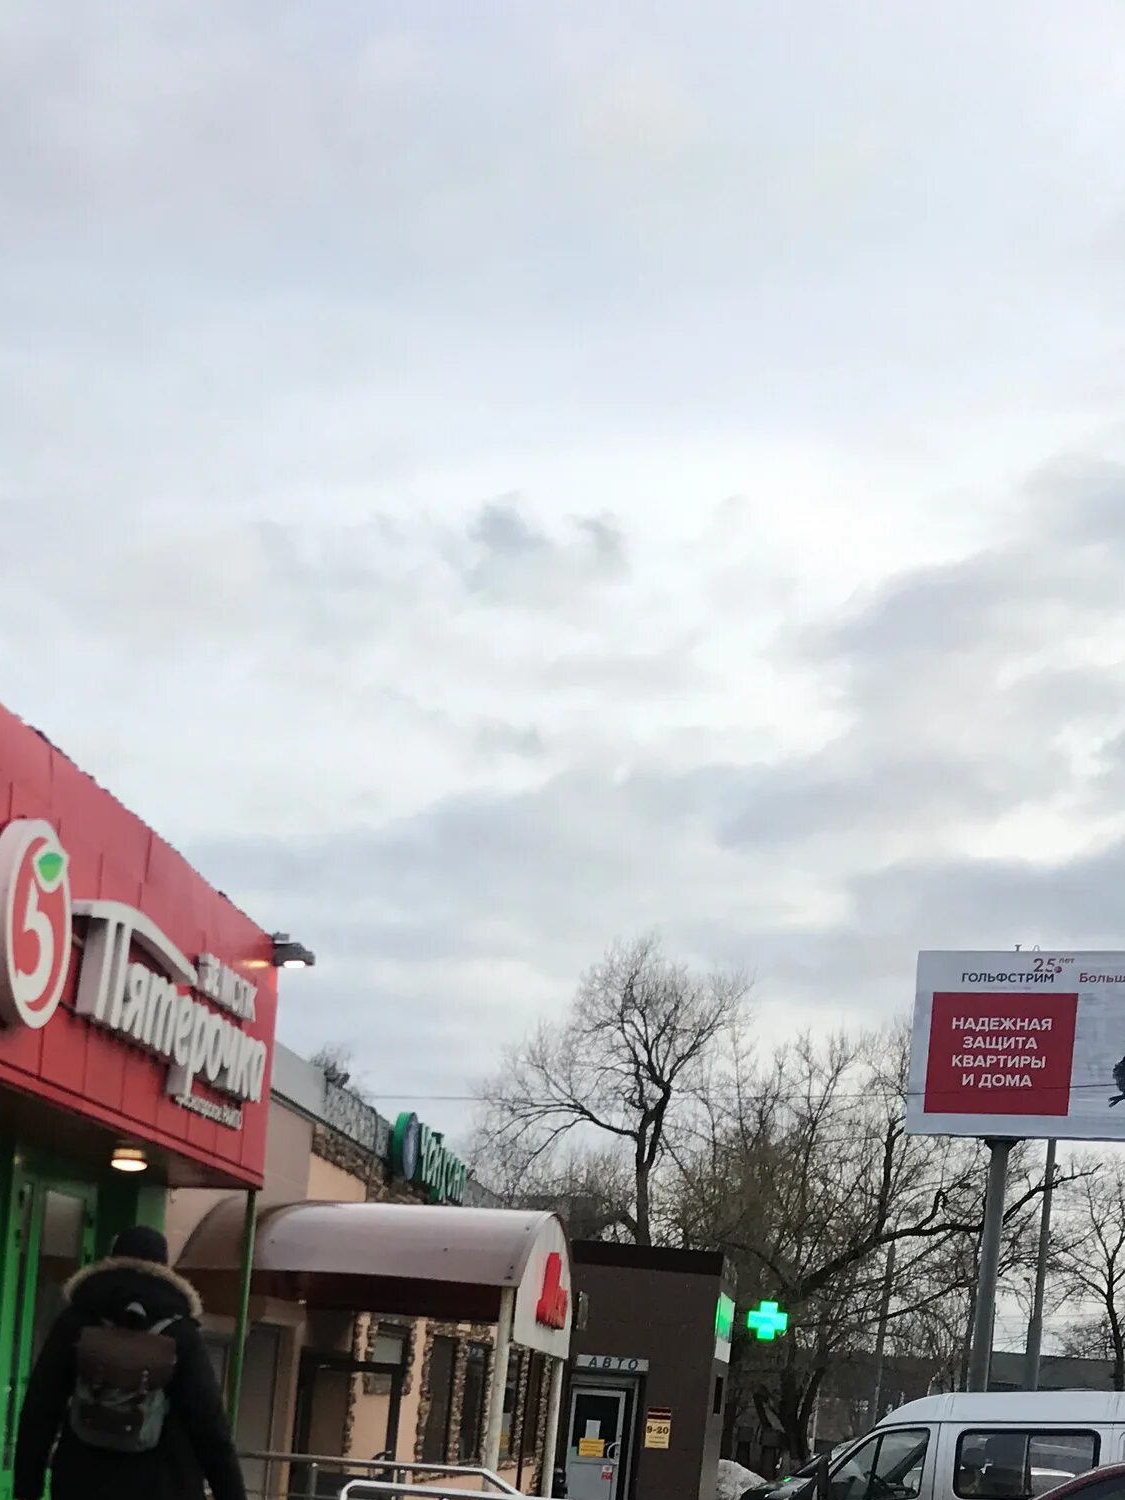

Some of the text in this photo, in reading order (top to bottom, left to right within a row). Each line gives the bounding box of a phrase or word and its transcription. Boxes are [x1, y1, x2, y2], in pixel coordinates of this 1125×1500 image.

[1032, 957, 1058, 974] 25
[961, 972, 1055, 984] ГОЛЬФСТРИМ
[70, 898, 268, 1104] Пятерочка
[951, 1016, 1053, 1032] НАДЕЖНАЯ
[962, 1036, 1038, 1051] ЗАЩИТА
[951, 1054, 1047, 1069] КВАРТИРЫ
[961, 1073, 1033, 1089] И ДОМА
[588, 1356, 639, 1371] АВТО
[646, 1425, 669, 1435] 9-20
